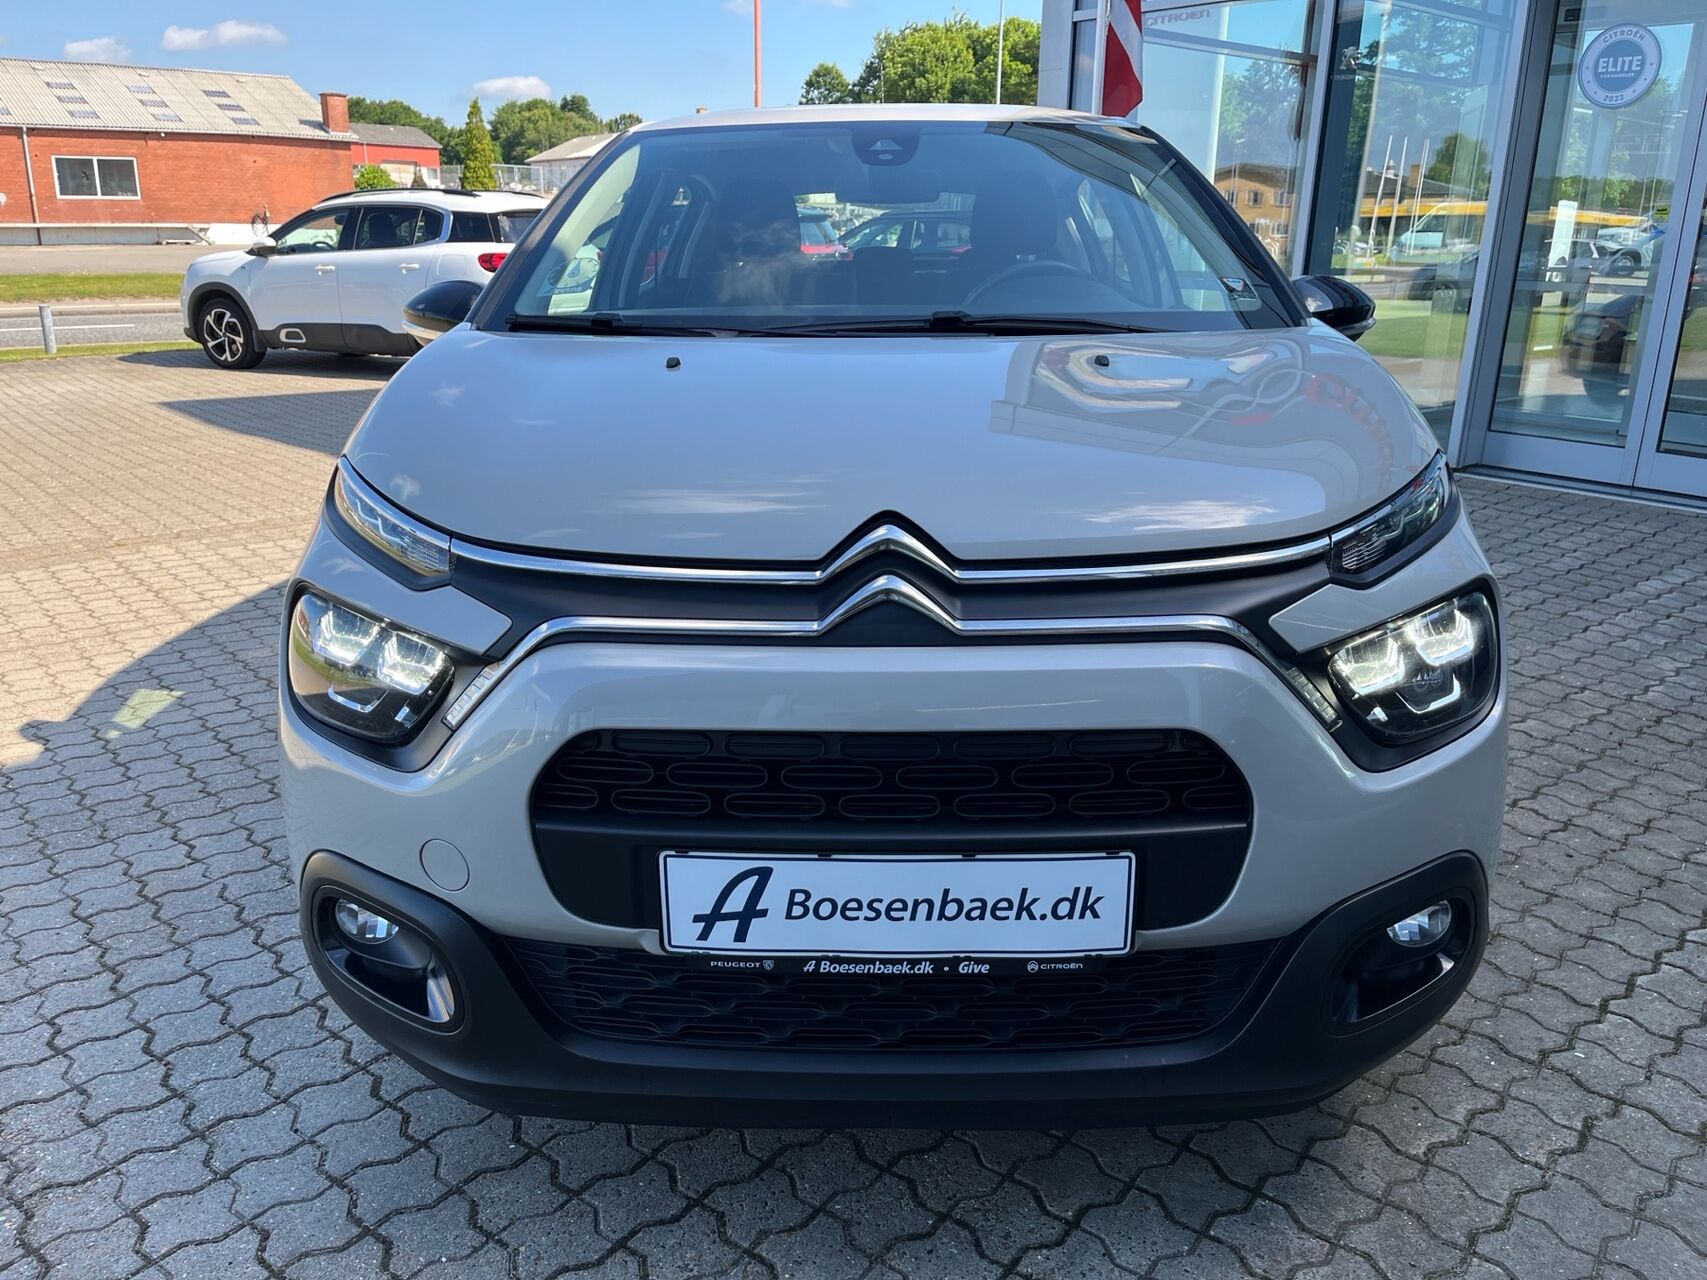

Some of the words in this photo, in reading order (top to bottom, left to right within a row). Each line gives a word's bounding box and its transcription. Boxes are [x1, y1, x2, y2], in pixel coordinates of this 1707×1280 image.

[1597, 55, 1643, 72] ELITE
[1603, 94, 1625, 103] 2023
[692, 866, 774, 943] A
[784, 886, 1106, 922] Boesenbaek.dk
[819, 961, 934, 974] Boesenbaek.dk
[958, 961, 990, 974] Give
